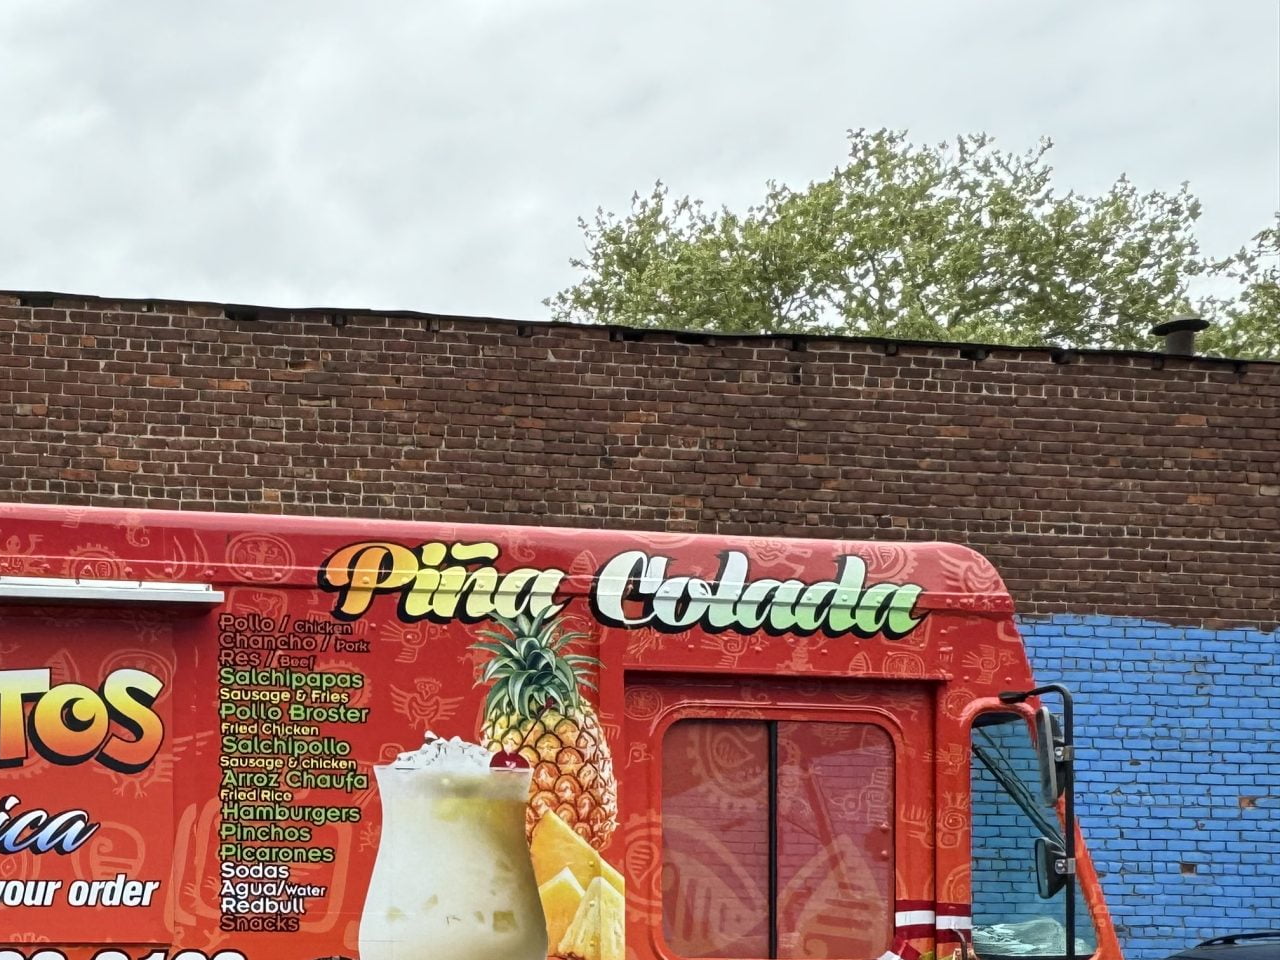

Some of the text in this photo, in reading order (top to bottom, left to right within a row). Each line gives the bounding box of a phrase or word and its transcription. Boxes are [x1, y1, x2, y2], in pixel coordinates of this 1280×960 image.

[321, 541, 929, 637] Piña Colada
[220, 615, 352, 635] Pollo / Chicken
[220, 632, 369, 652] Chancho / Pork
[220, 650, 260, 667] Res
[280, 655, 315, 668] Beef
[220, 668, 363, 689] Salchipapas
[220, 688, 348, 703] Sausage & Fries
[220, 703, 368, 722] Pollo Broster
[221, 722, 319, 736] Fried Chicken
[222, 736, 350, 756] Salchipollo
[220, 756, 283, 769] Sausage
[288, 758, 297, 768] &
[221, 771, 368, 792] Arroz Chaufa
[220, 789, 293, 801] Fried Rice
[222, 803, 360, 823] Hamburgers
[220, 823, 311, 841] Pinchos
[220, 843, 335, 862] Picarones
[221, 862, 289, 878] Sodas
[68, 873, 161, 908] order
[221, 897, 305, 914] Redbull
[221, 915, 299, 931] Snacks
